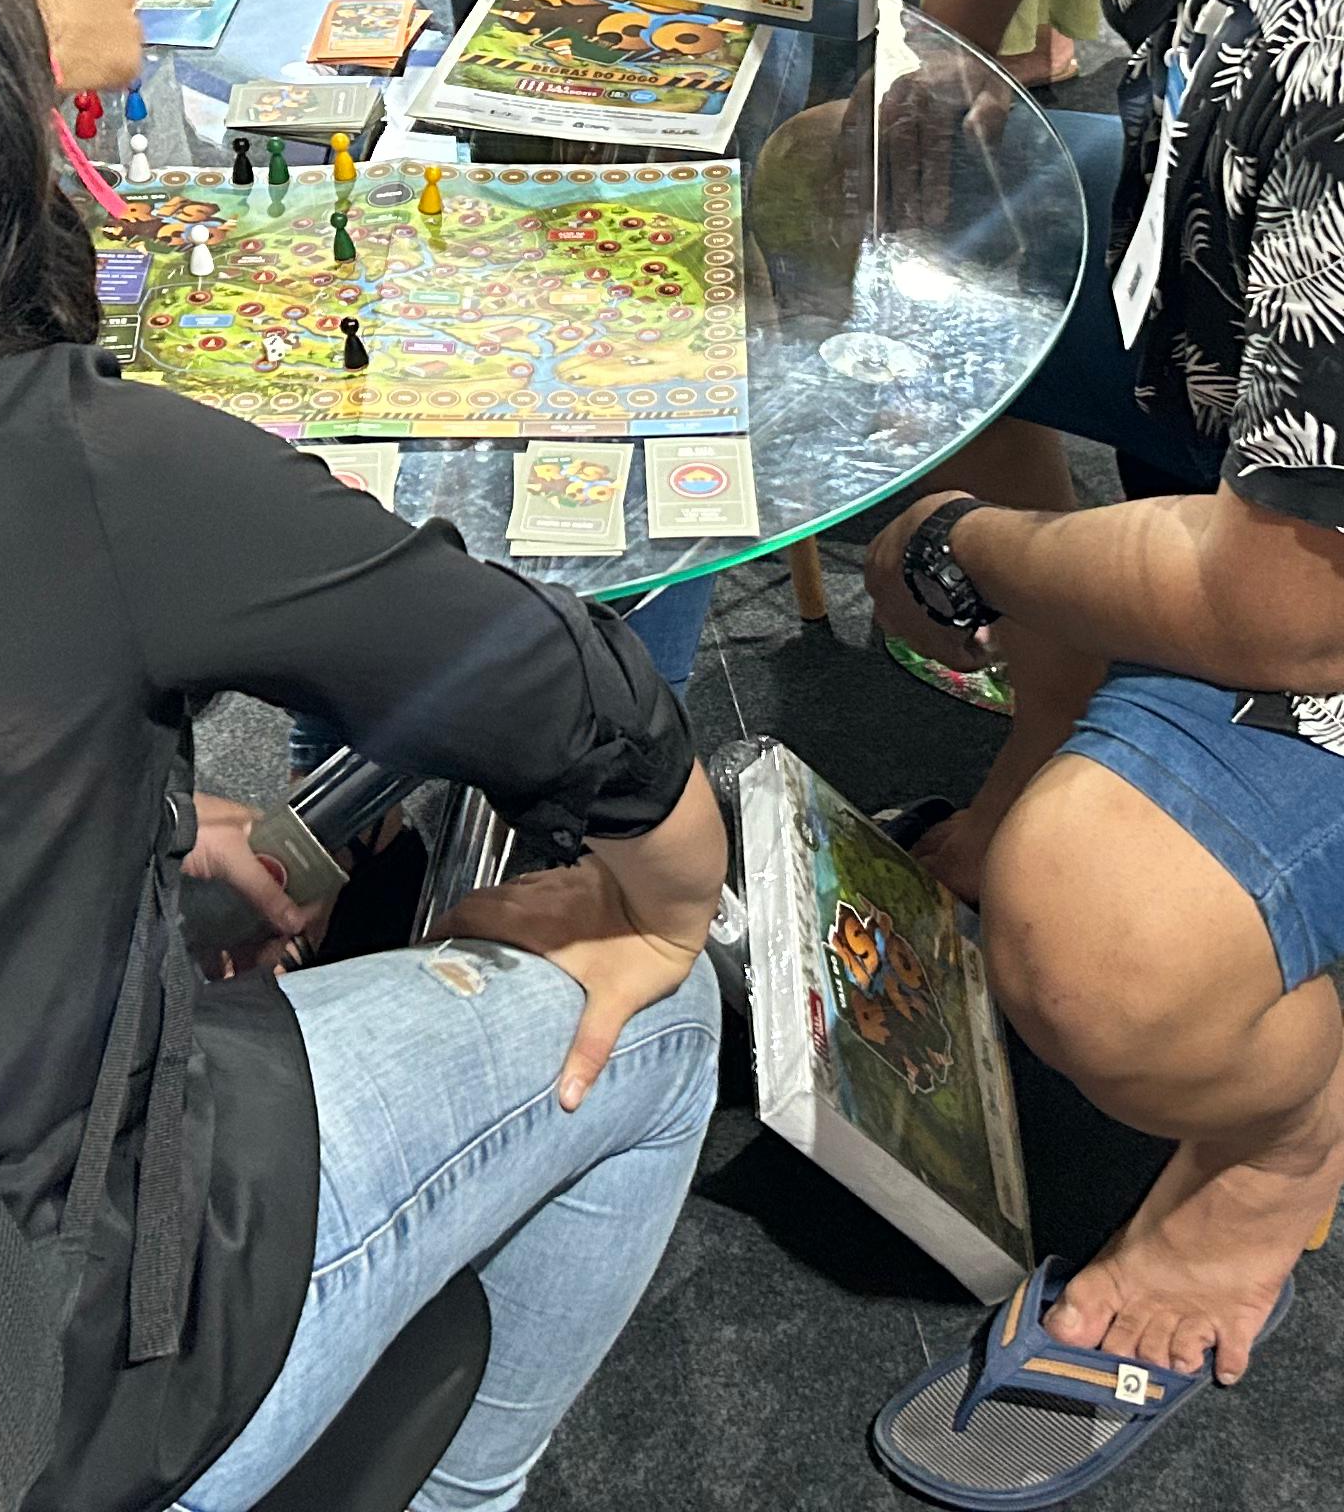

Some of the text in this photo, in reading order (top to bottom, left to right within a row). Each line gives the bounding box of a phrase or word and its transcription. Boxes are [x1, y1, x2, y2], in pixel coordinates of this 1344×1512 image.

[531, 64, 659, 83] REGRAS DO JOGO
